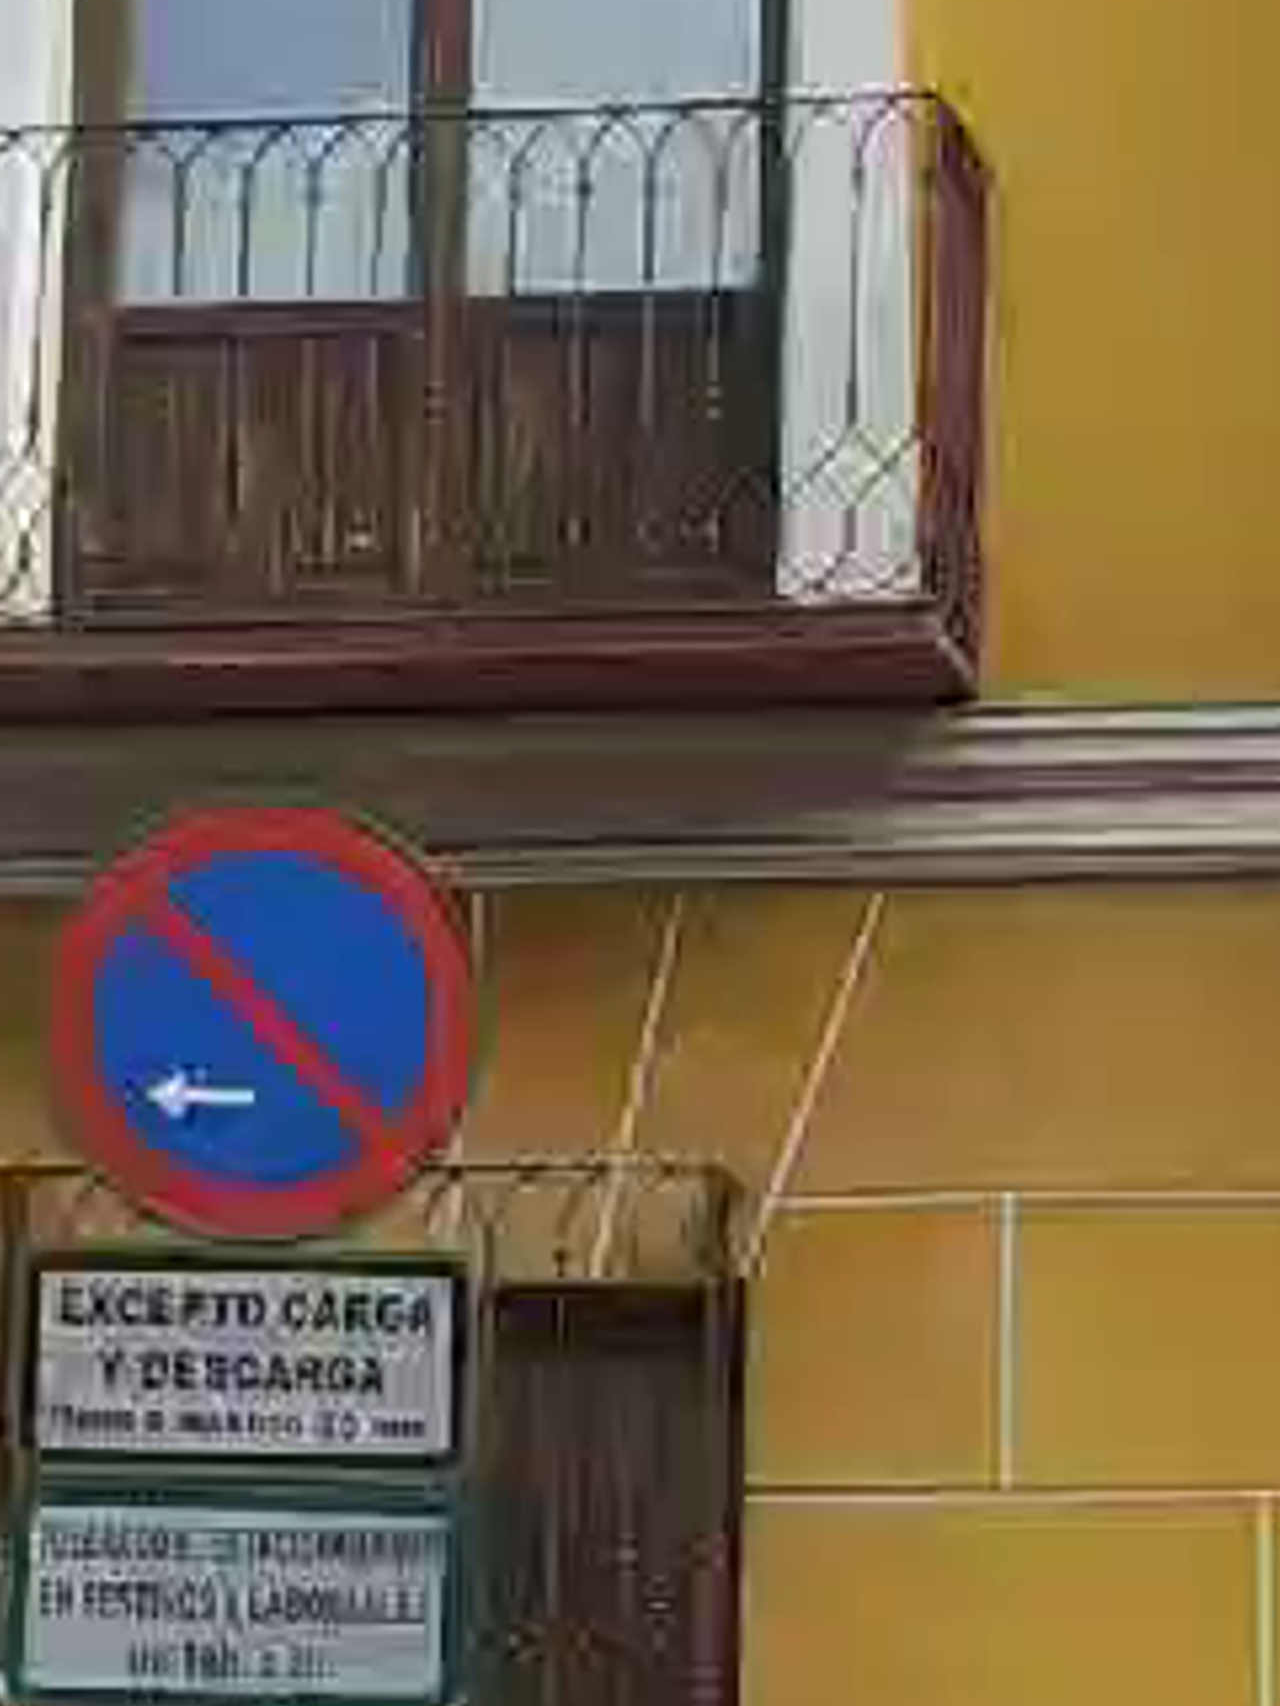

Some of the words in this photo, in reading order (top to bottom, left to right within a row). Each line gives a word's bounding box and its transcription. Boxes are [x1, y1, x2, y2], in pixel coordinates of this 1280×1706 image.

[59, 1277, 267, 1327] EXCEPTO
[281, 1291, 432, 1335] CARGA
[100, 1350, 125, 1386] Y
[138, 1351, 384, 1395] DESCARGA
